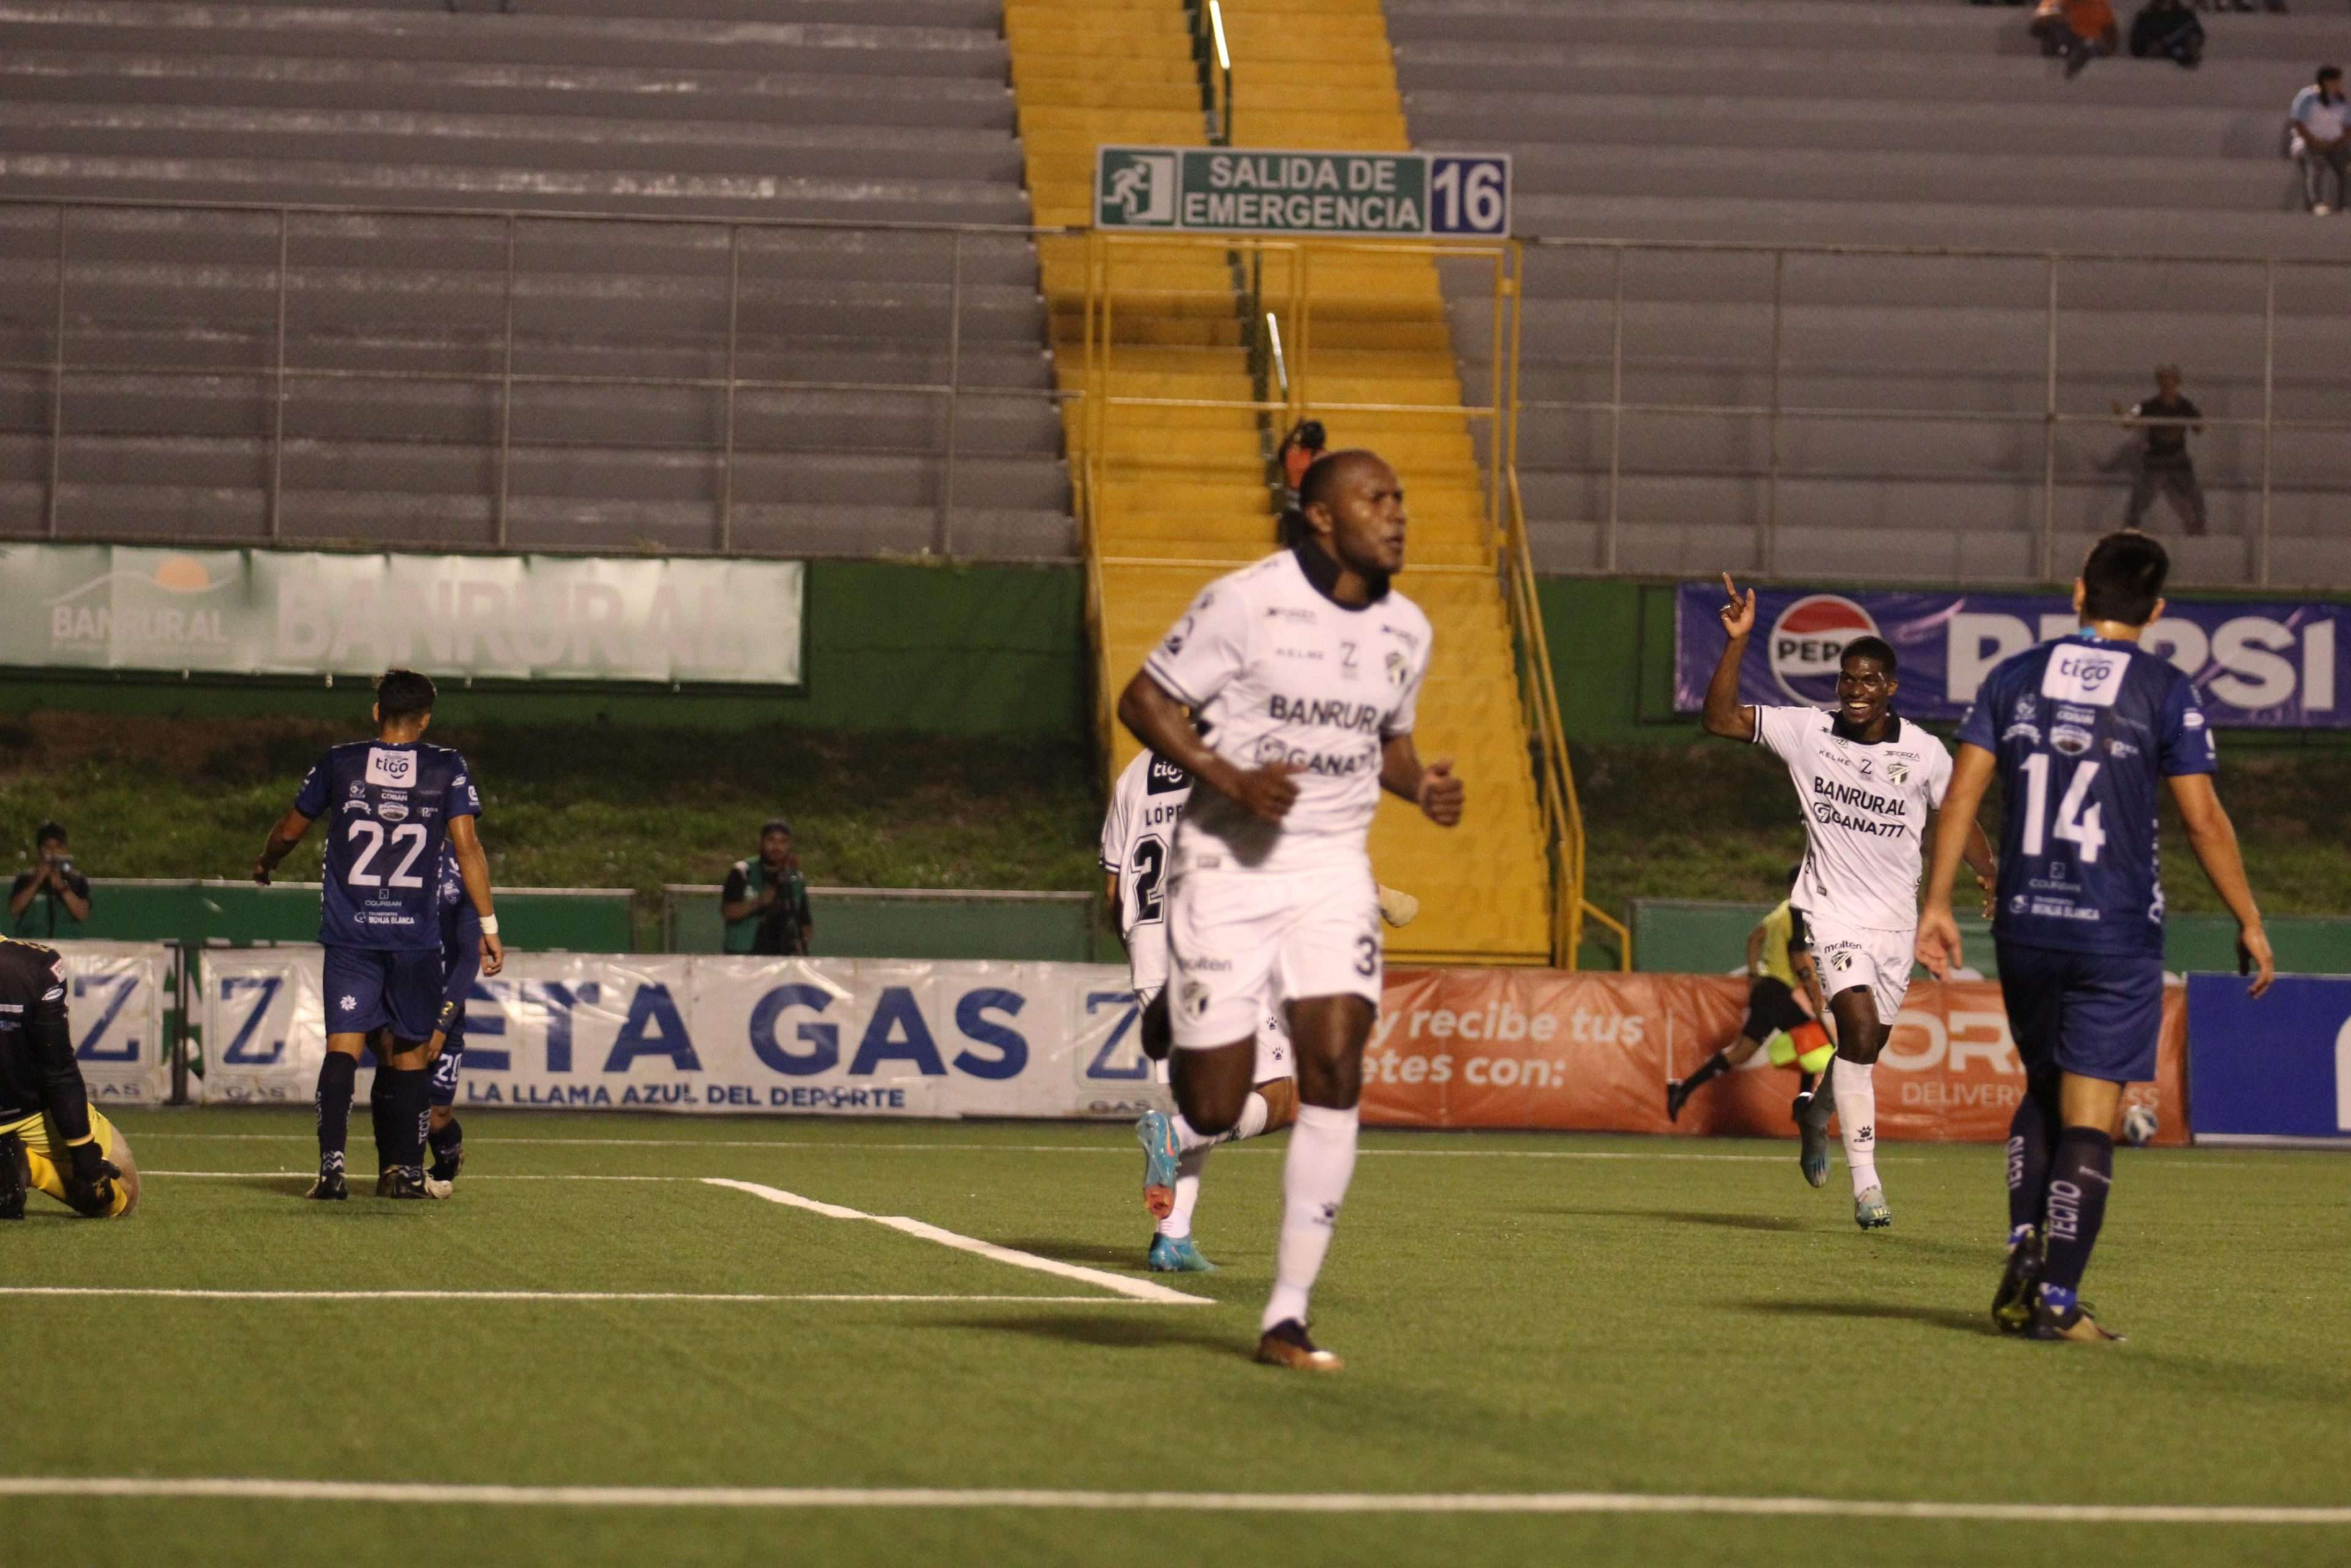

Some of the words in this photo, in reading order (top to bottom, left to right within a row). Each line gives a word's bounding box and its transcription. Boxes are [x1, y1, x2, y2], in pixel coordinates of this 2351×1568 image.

[1210, 157, 1341, 192] SALIDA
[1349, 159, 1396, 192] DE
[1185, 193, 1421, 229] EMERGENCIA
[1433, 162, 1502, 231] 16
[51, 607, 230, 642] BANRURAL
[277, 579, 744, 669] BANRURAL
[2060, 658, 2110, 691] tigo
[375, 758, 409, 779] tigo
[1819, 749, 1851, 765] KELME
[1814, 776, 1906, 816] BANRURAL
[2019, 753, 2106, 863] 14
[1831, 809, 1905, 838] GANA777
[348, 820, 427, 888] 22
[1354, 934, 1378, 977] 3
[1824, 940, 1862, 954] molten
[73, 974, 139, 1061] Z
[220, 976, 285, 1064] Z
[360, 981, 703, 1073] ETA
[749, 983, 1029, 1079] GAS
[1086, 992, 1148, 1080] Z
[1410, 1002, 1559, 1041] recibe
[1571, 1007, 1645, 1044] tus
[433, 1052, 462, 1082] 20
[1466, 1056, 1567, 1087] con:
[467, 1081, 502, 1102] LA
[512, 1082, 611, 1103] LLAMA
[621, 1082, 698, 1103] AZUL
[707, 1085, 762, 1106] DEL
[770, 1087, 906, 1108] DEPORTE
[2048, 1180, 2082, 1241] TECNO
